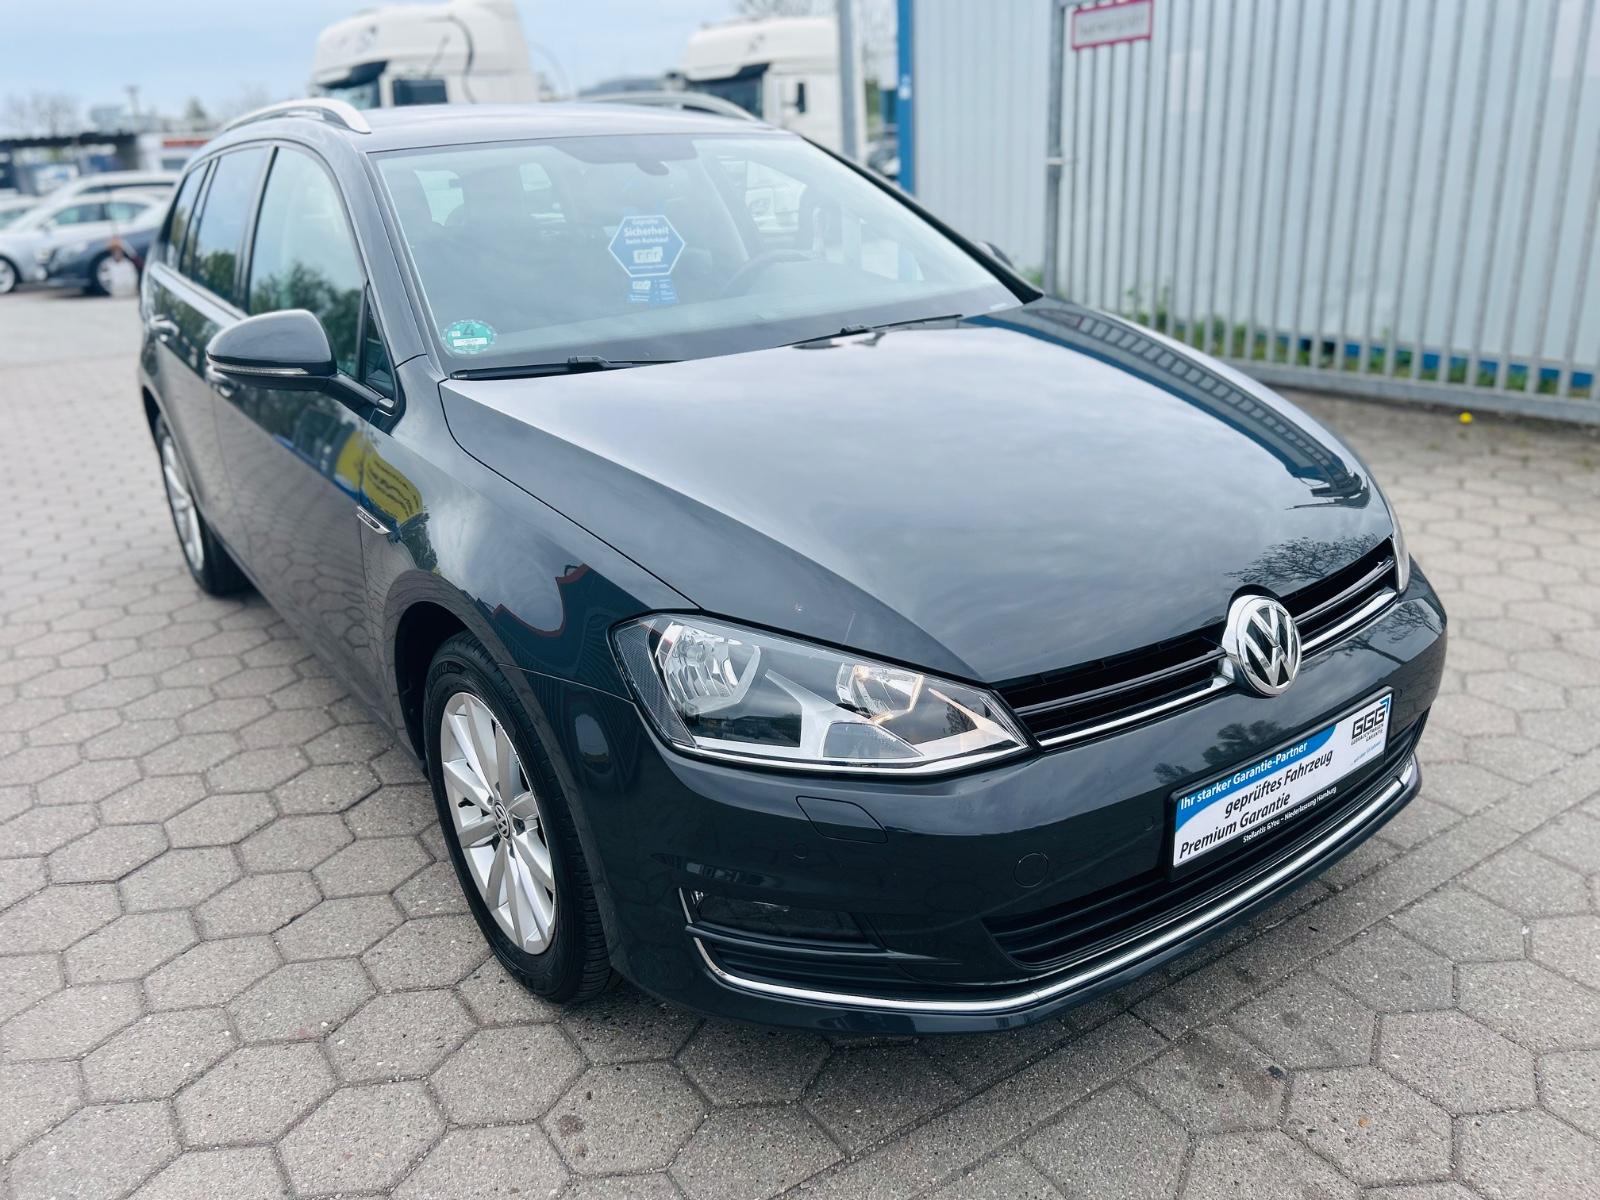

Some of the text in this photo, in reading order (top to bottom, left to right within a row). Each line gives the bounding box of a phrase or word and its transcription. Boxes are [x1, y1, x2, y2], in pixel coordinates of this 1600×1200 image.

[623, 226, 669, 238] Sicherheit
[1352, 704, 1387, 739] GGG
[1181, 742, 1307, 810] Ihr starker Garantie-Partner
[1224, 778, 1282, 819] geprüftes
[1283, 750, 1333, 786] Fahrzeug
[1179, 793, 1291, 859] Premium Garantie
